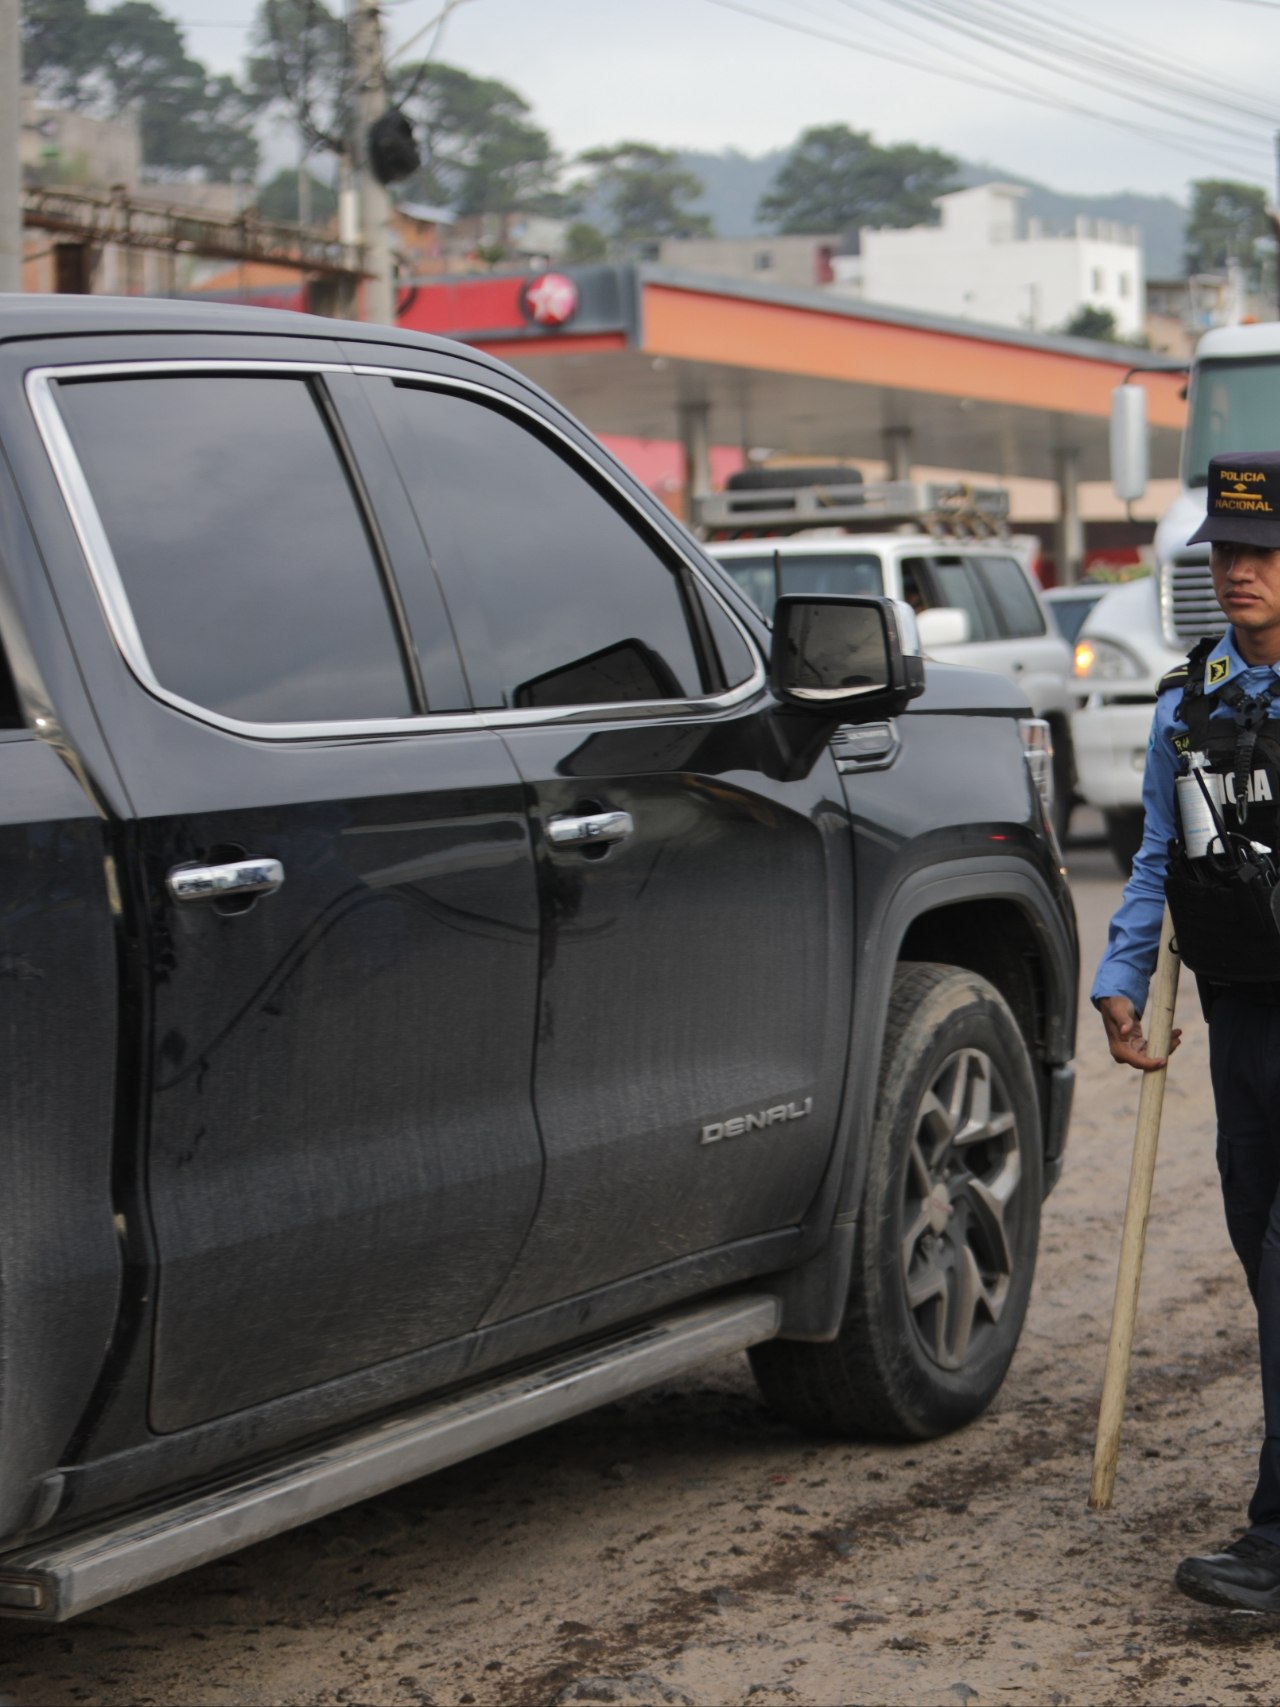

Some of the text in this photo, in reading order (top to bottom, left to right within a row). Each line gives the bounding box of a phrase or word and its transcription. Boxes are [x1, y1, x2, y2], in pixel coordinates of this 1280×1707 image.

[1220, 470, 1266, 482] POLICIA
[1215, 499, 1274, 511] NACIONAL
[701, 1096, 813, 1144] DENALI
